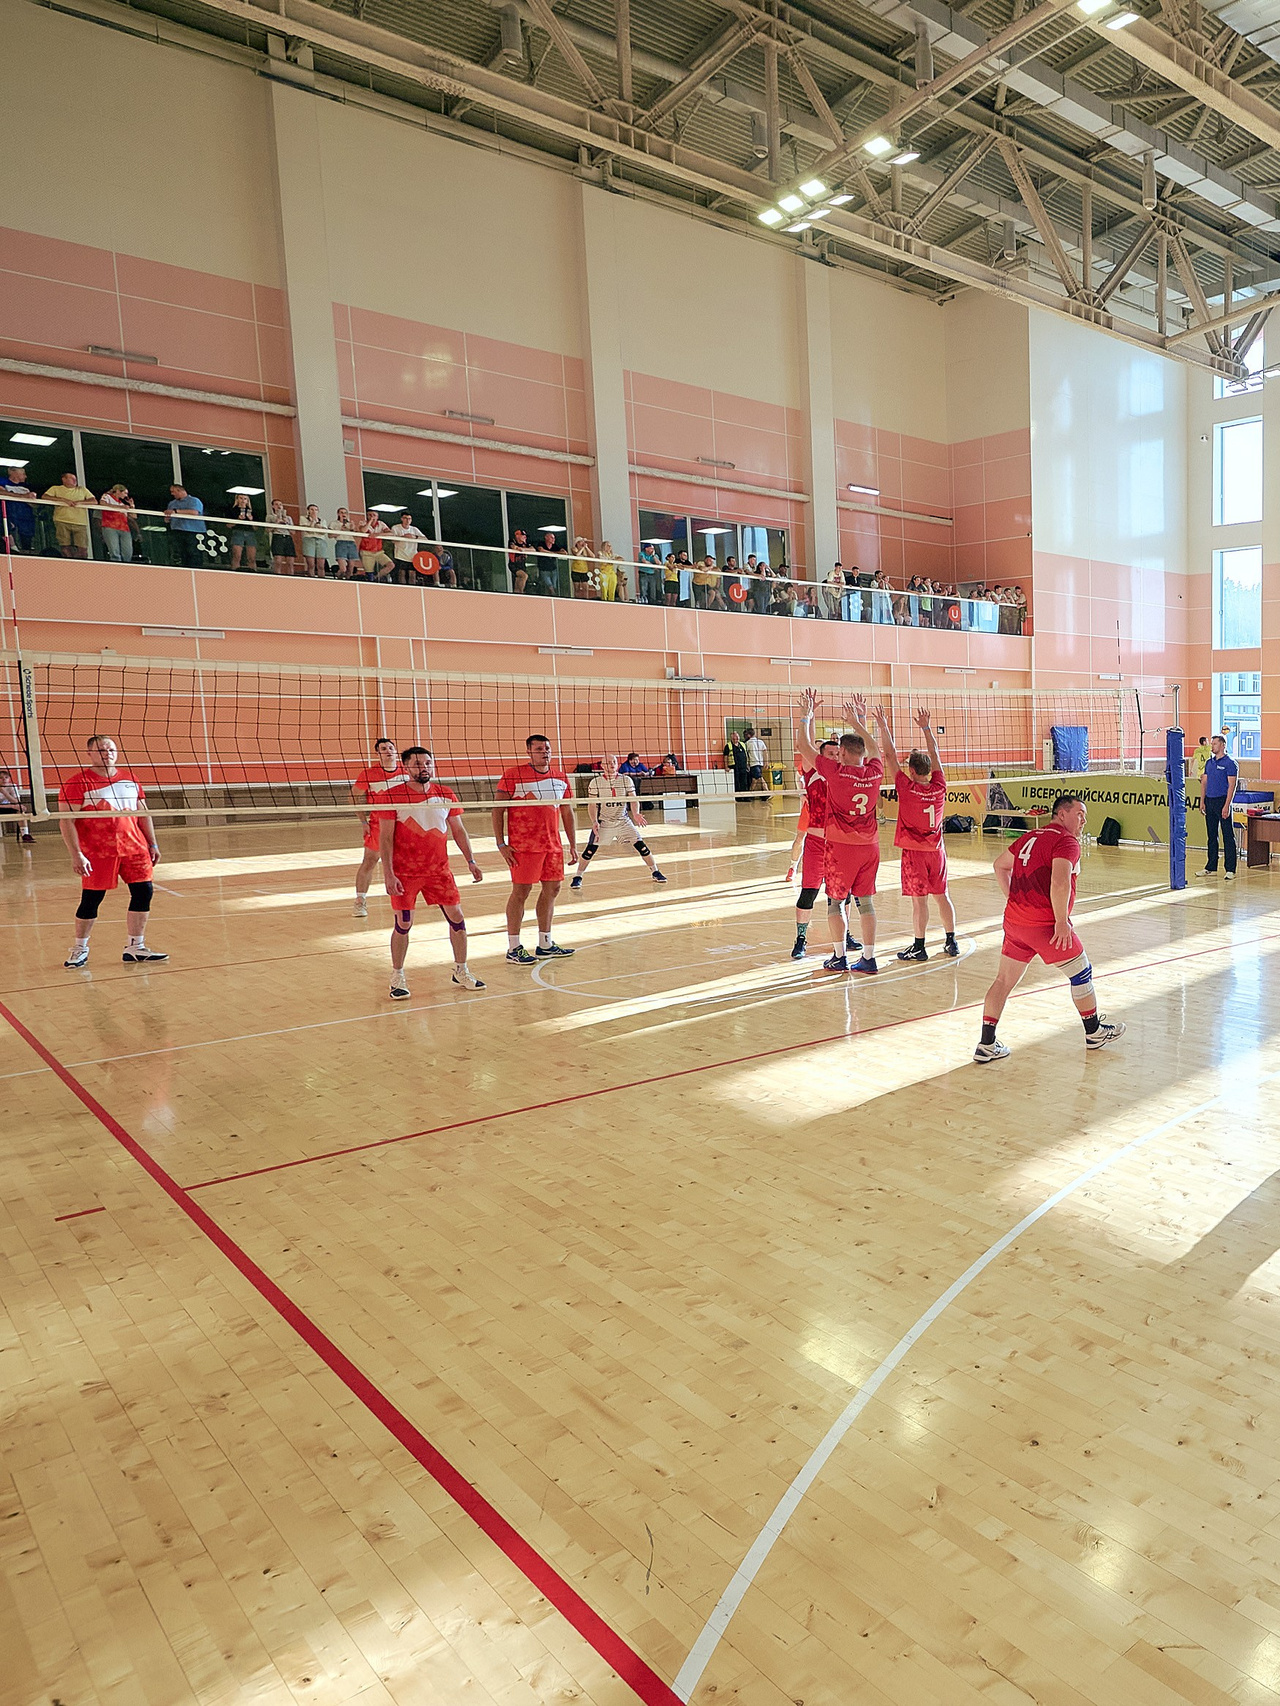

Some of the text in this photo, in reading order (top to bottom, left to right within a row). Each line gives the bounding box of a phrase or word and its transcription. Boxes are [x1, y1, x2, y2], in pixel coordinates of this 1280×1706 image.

[850, 793, 869, 816] 3
[947, 791, 971, 804] СУЭК
[1122, 792, 1201, 810] СПАРТААД
[923, 804, 936, 828] 1
[1018, 836, 1038, 867] 4
